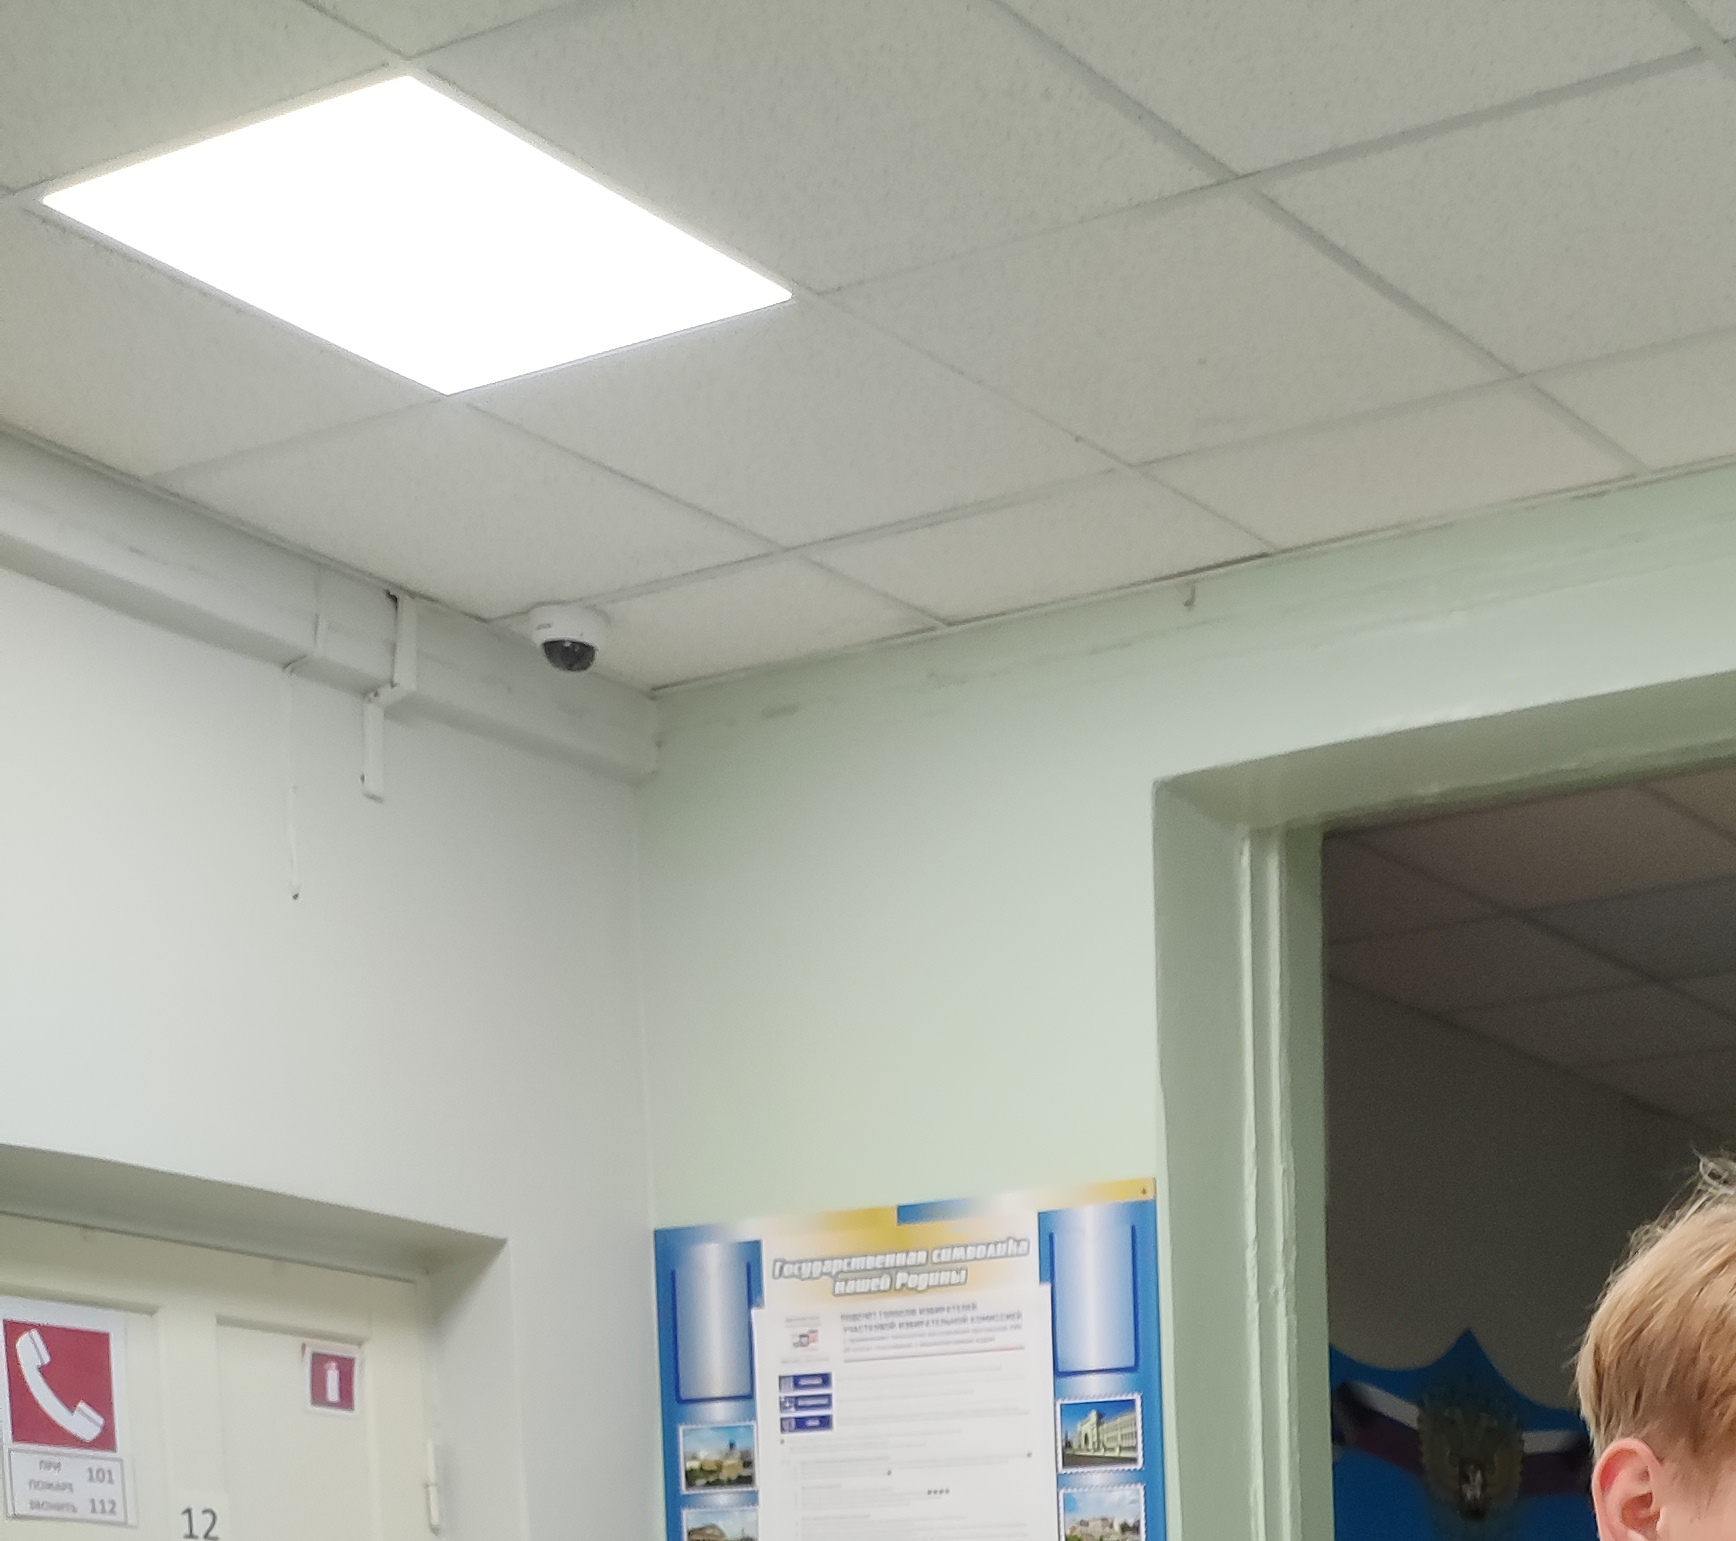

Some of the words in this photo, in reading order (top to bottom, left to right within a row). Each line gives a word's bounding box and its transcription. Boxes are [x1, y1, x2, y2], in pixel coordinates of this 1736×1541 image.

[88, 1467, 114, 1484] 101
[90, 1498, 117, 1515] 112
[182, 1507, 220, 1541] 12
